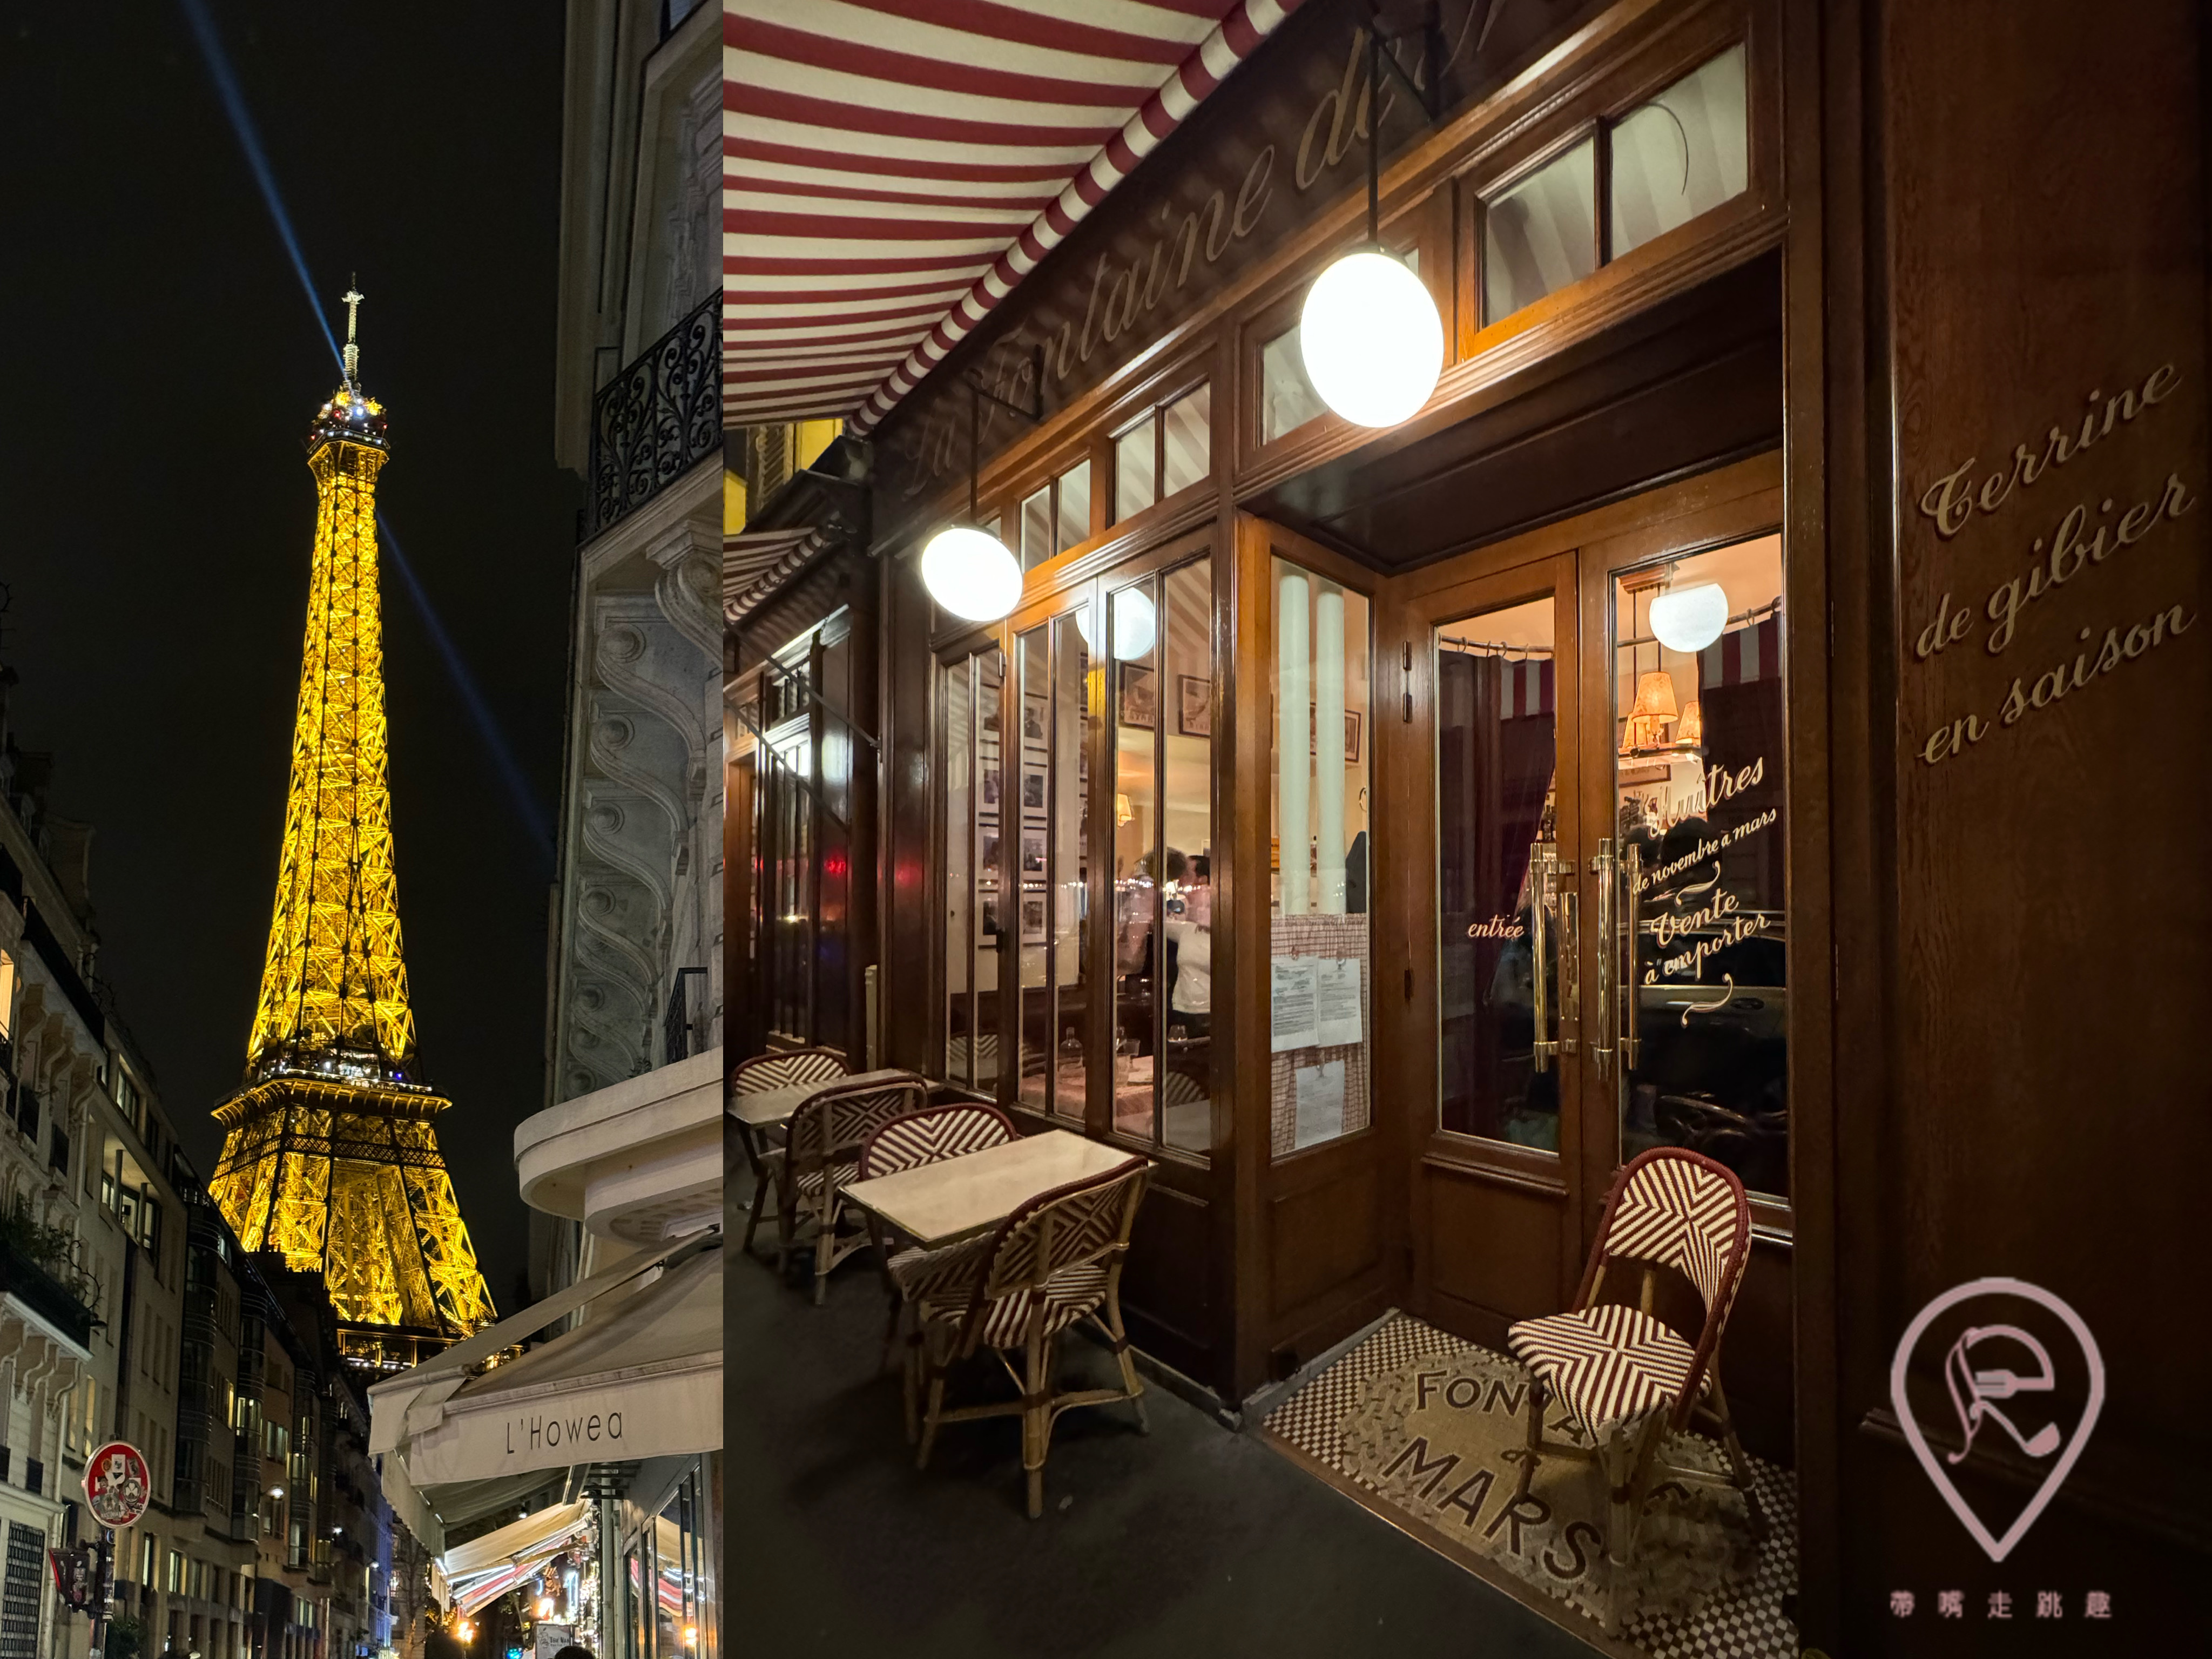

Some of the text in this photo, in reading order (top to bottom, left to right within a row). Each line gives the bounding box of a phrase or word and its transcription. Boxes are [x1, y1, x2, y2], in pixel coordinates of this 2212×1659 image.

[1921, 364, 2182, 537] Terrine
[1915, 473, 2196, 658] de gibier
[1917, 604, 2197, 765] en saison
[1633, 873, 1649, 894] de
[1651, 838, 1719, 885] novembre
[1733, 808, 1776, 841] mars
[1468, 914, 1525, 938] entrée
[1645, 913, 1771, 984] à emporter
[1650, 888, 1739, 948] Vente
[507, 1411, 622, 1454] L'Howea
[1381, 1438, 1601, 1580] MARS
